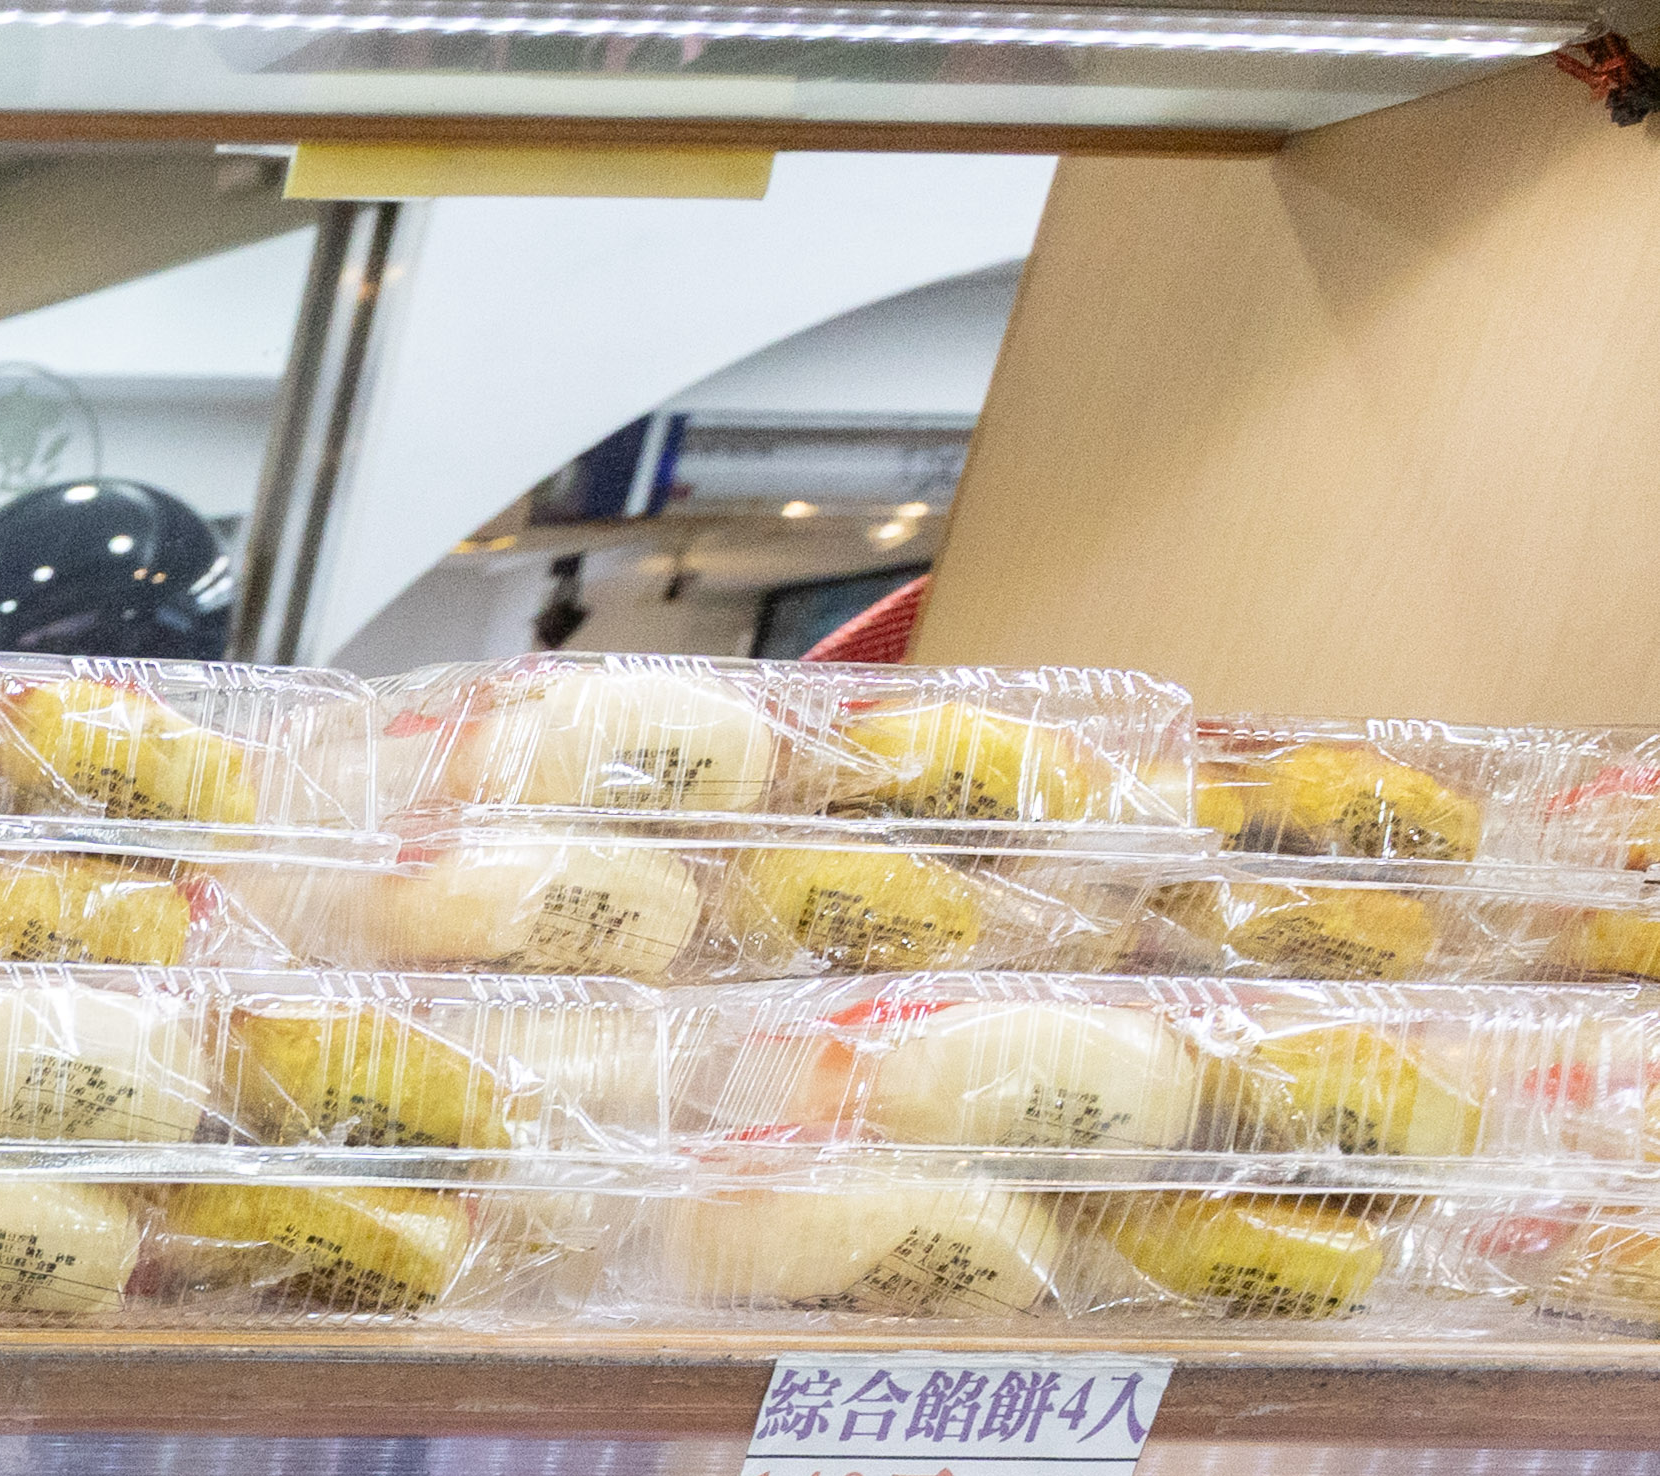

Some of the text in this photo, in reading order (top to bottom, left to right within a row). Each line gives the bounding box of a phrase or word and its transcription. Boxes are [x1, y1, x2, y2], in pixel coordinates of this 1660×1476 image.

[756, 1368, 1149, 1444] 綜合餡餅4入
